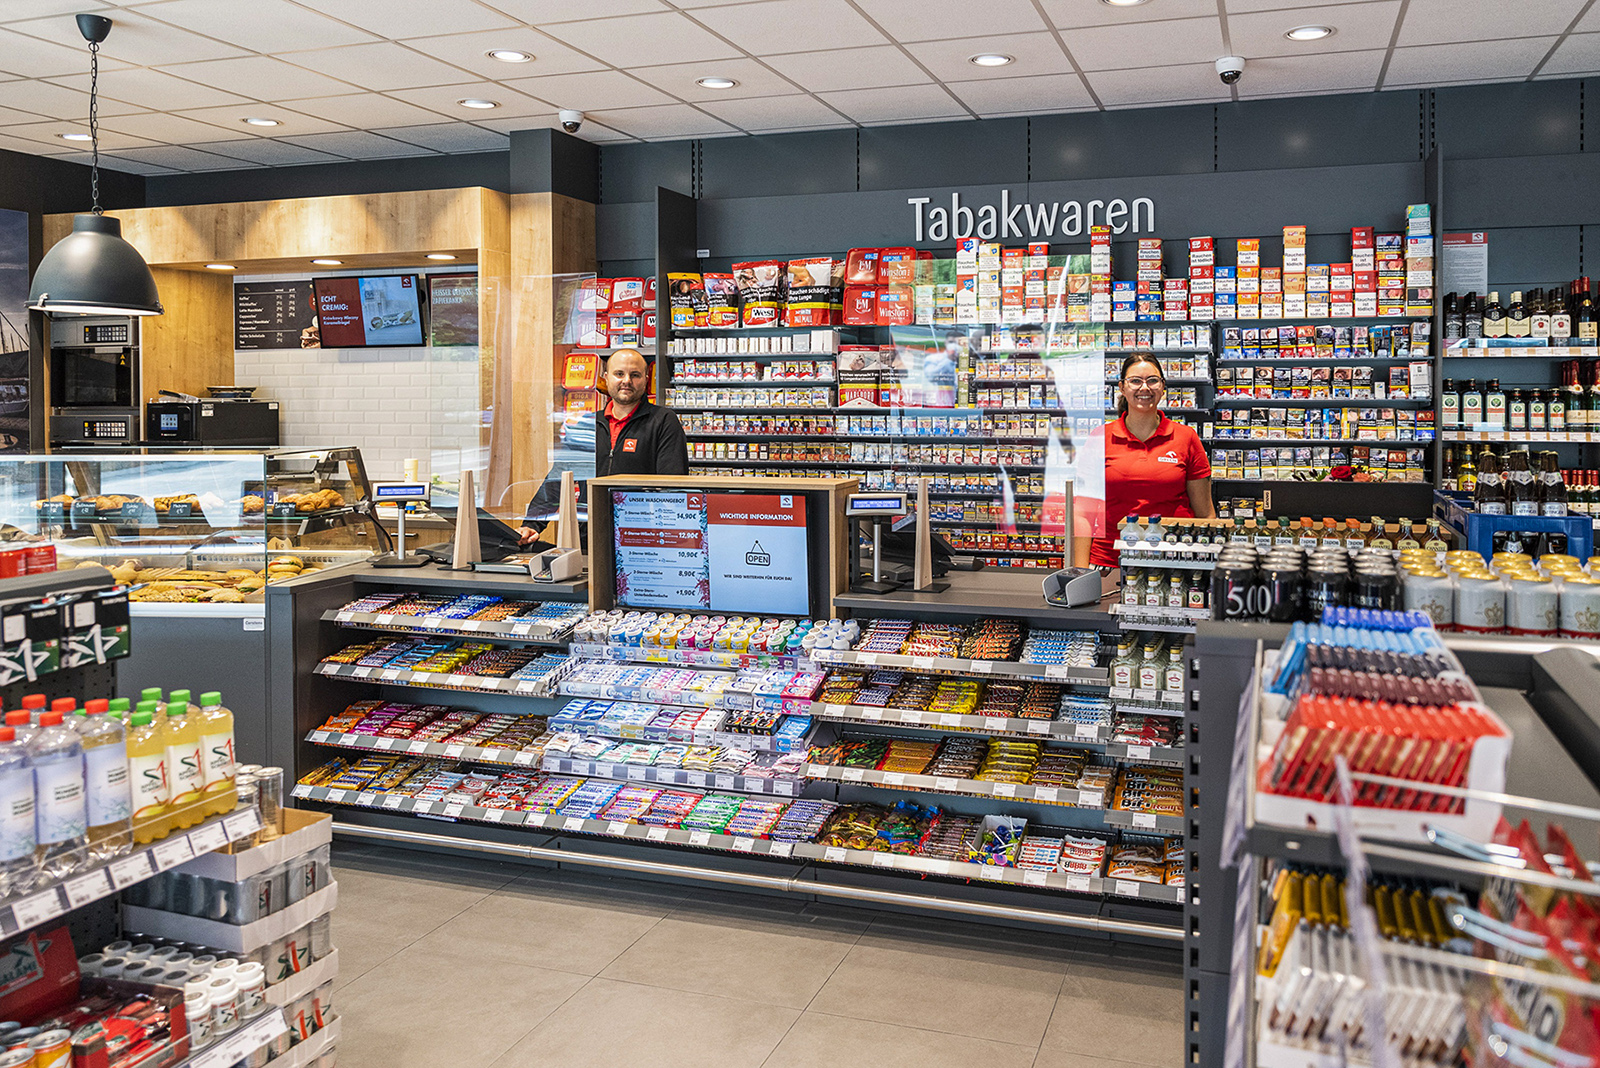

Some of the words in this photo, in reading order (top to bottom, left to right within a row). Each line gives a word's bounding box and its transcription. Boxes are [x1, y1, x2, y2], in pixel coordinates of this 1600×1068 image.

[907, 189, 1155, 243] Tabakwaren
[880, 266, 907, 277] Winston
[320, 295, 337, 303] ECHT
[321, 303, 349, 312] CREMIG:
[753, 308, 774, 317] West
[879, 307, 906, 318] Winston
[845, 391, 875, 402] MARLBORO
[749, 513, 793, 521] INFORMATION
[747, 555, 769, 563] OPEN
[1225, 585, 1272, 616] 5,00
[919, 623, 950, 631] TWIX
[978, 709, 1010, 718] TWIX
